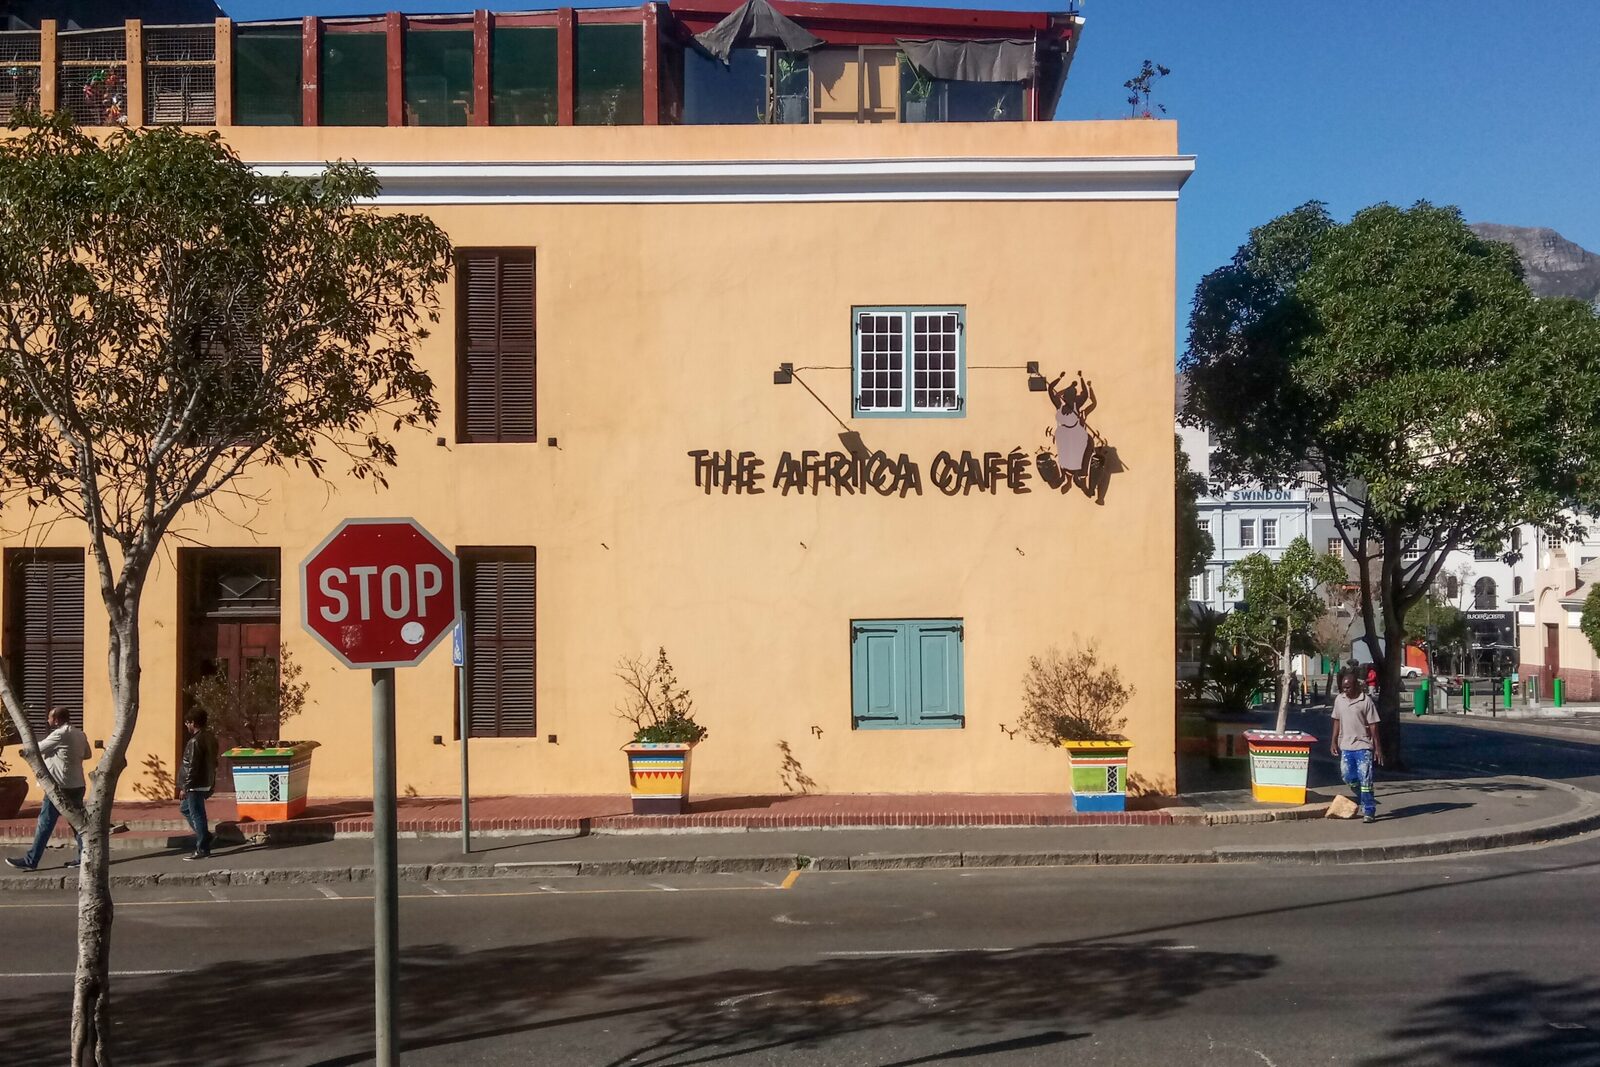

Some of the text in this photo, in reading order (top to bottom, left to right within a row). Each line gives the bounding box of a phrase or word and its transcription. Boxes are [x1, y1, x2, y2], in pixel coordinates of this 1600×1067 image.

[687, 446, 1031, 497] THE AFRICA CAFÉ
[1233, 491, 1292, 501] SWINDON
[319, 563, 443, 622] STOP
